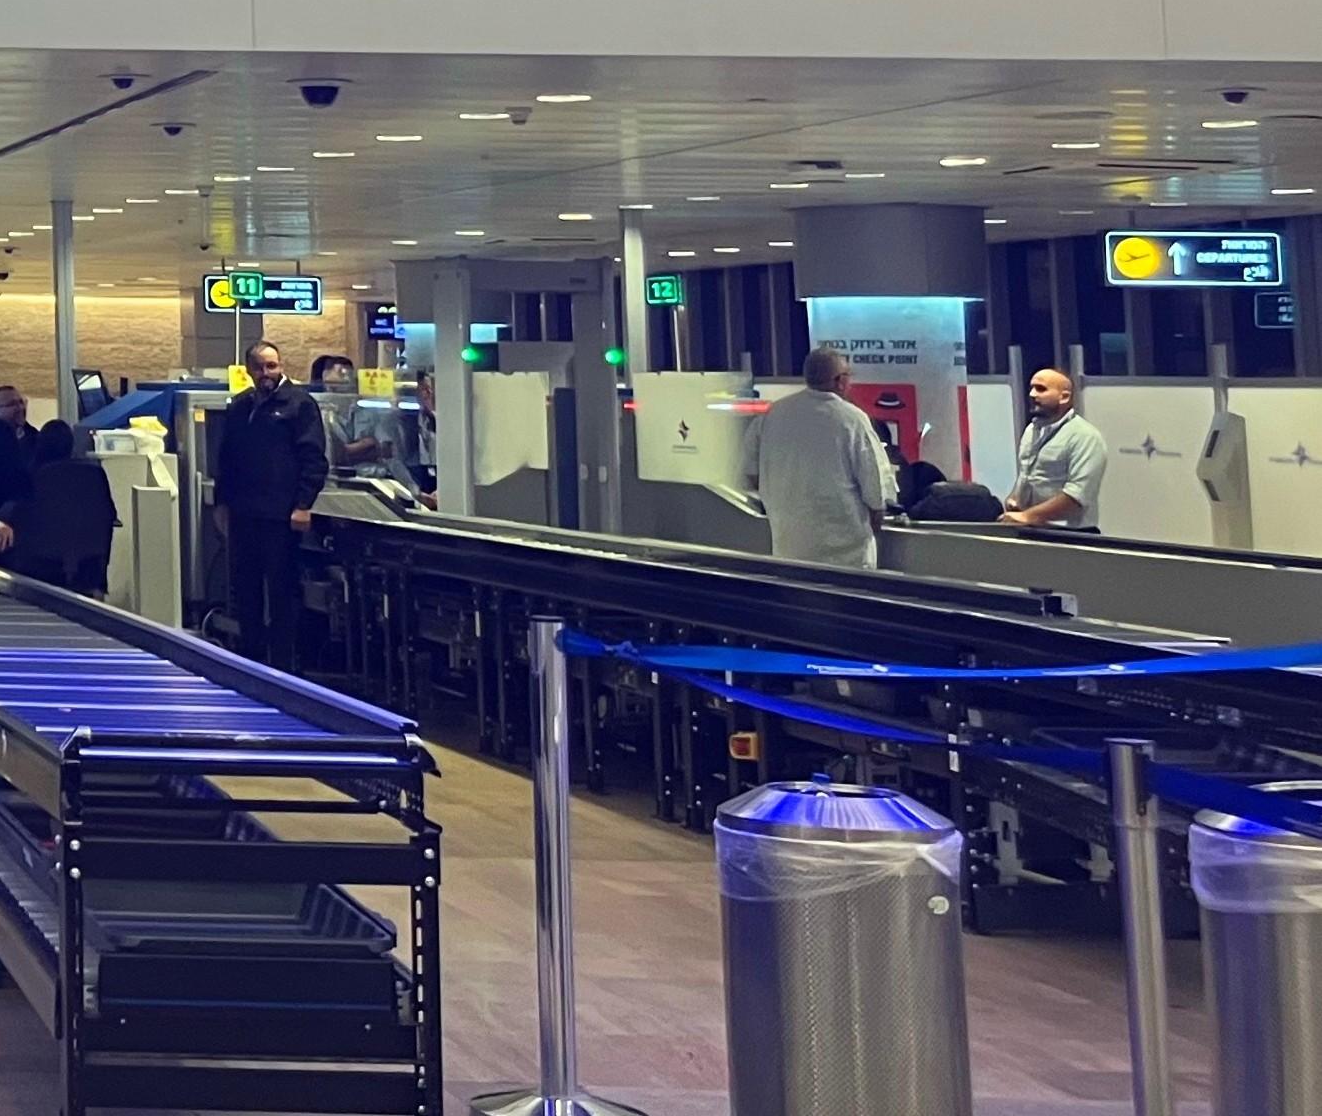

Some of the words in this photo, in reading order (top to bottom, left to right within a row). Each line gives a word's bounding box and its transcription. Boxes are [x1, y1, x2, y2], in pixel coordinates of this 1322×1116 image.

[1196, 252, 1269, 264] DEPARTURES
[236, 277, 257, 295] 11
[651, 281, 674, 298] 12
[850, 340, 885, 351] בידוק
[852, 354, 885, 364] CHECK
[888, 355, 918, 364] POINT
